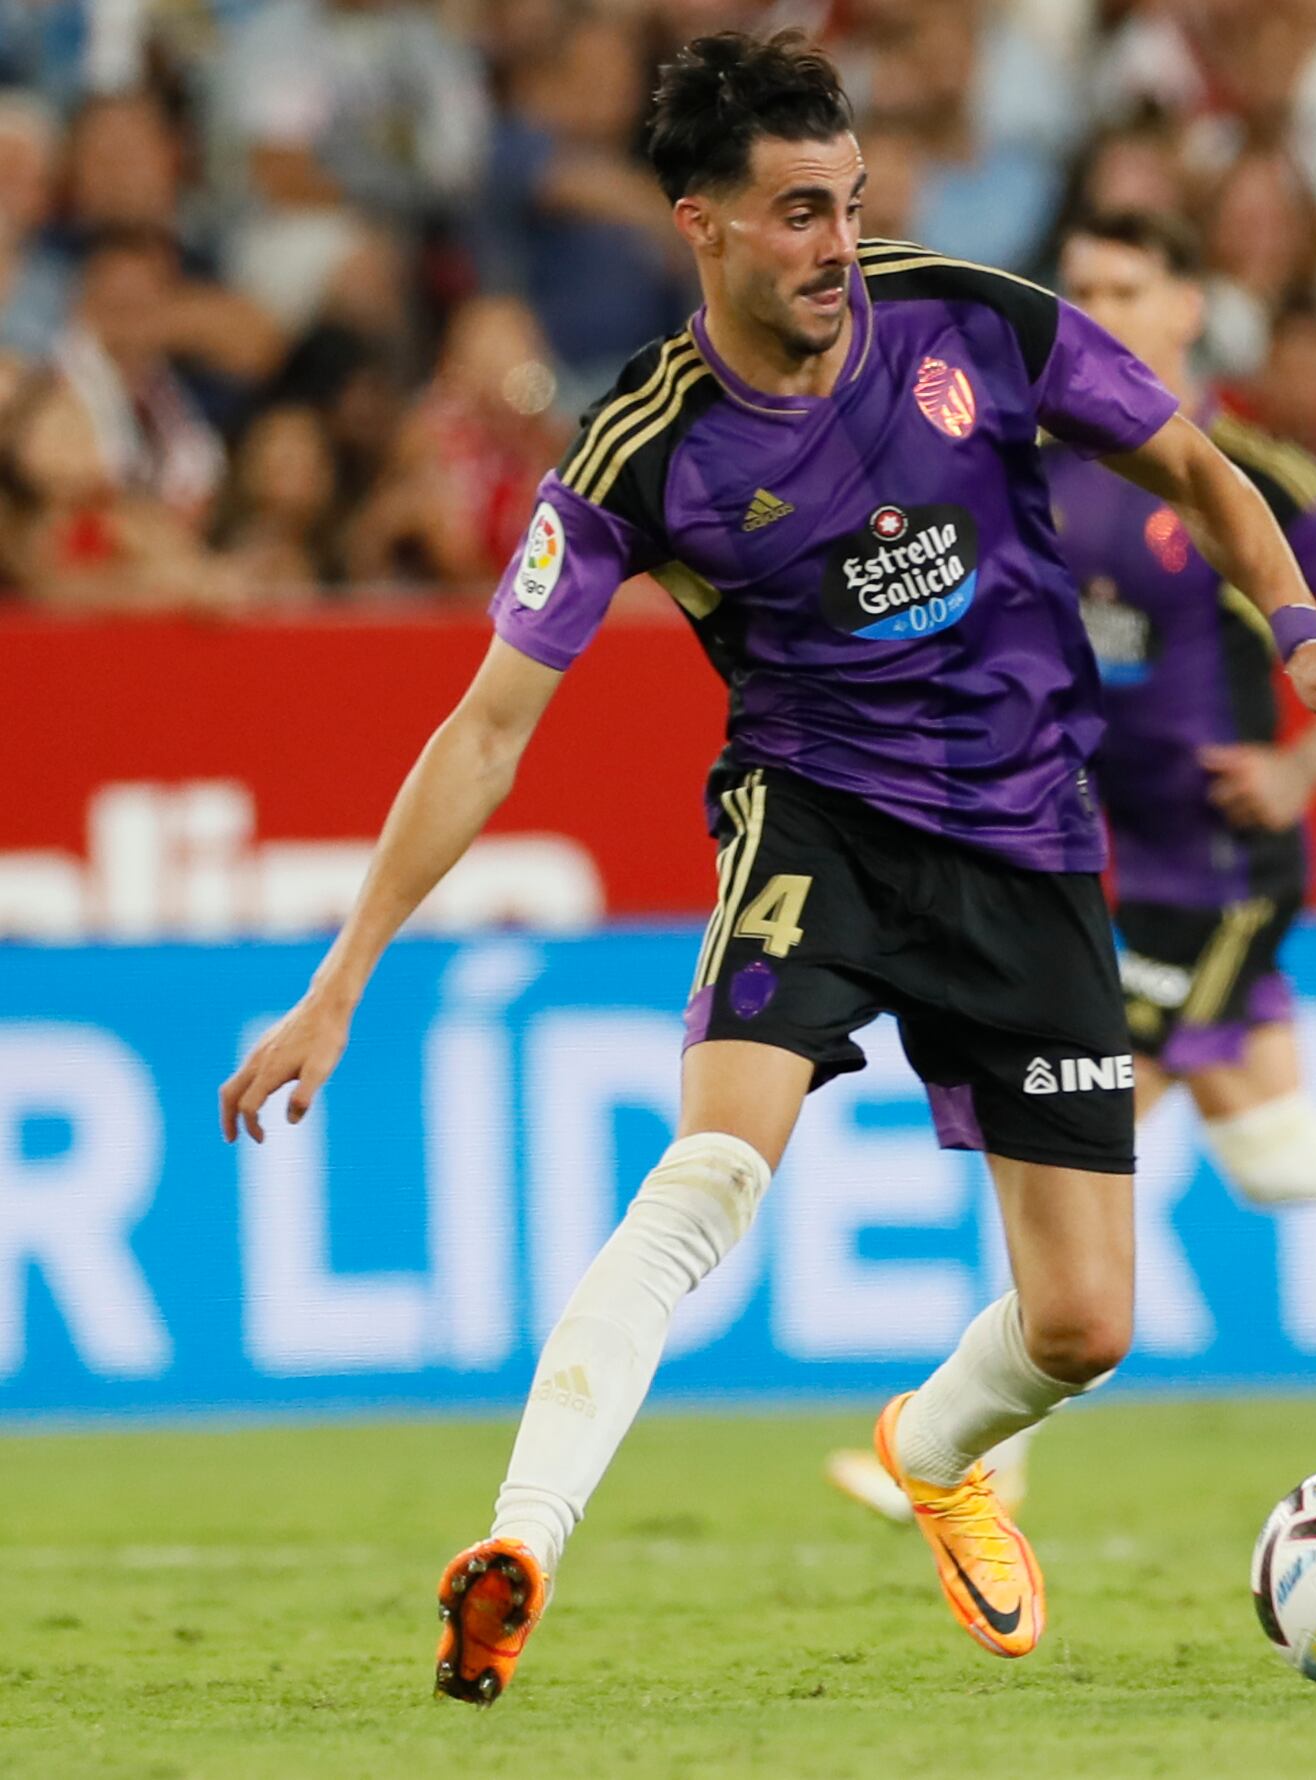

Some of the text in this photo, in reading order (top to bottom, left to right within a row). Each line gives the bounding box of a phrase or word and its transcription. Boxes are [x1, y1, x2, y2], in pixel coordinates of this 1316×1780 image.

[742, 504, 795, 532] adidas
[843, 523, 957, 590] Estrella
[859, 555, 965, 614] Galicia
[733, 874, 812, 959] 4
